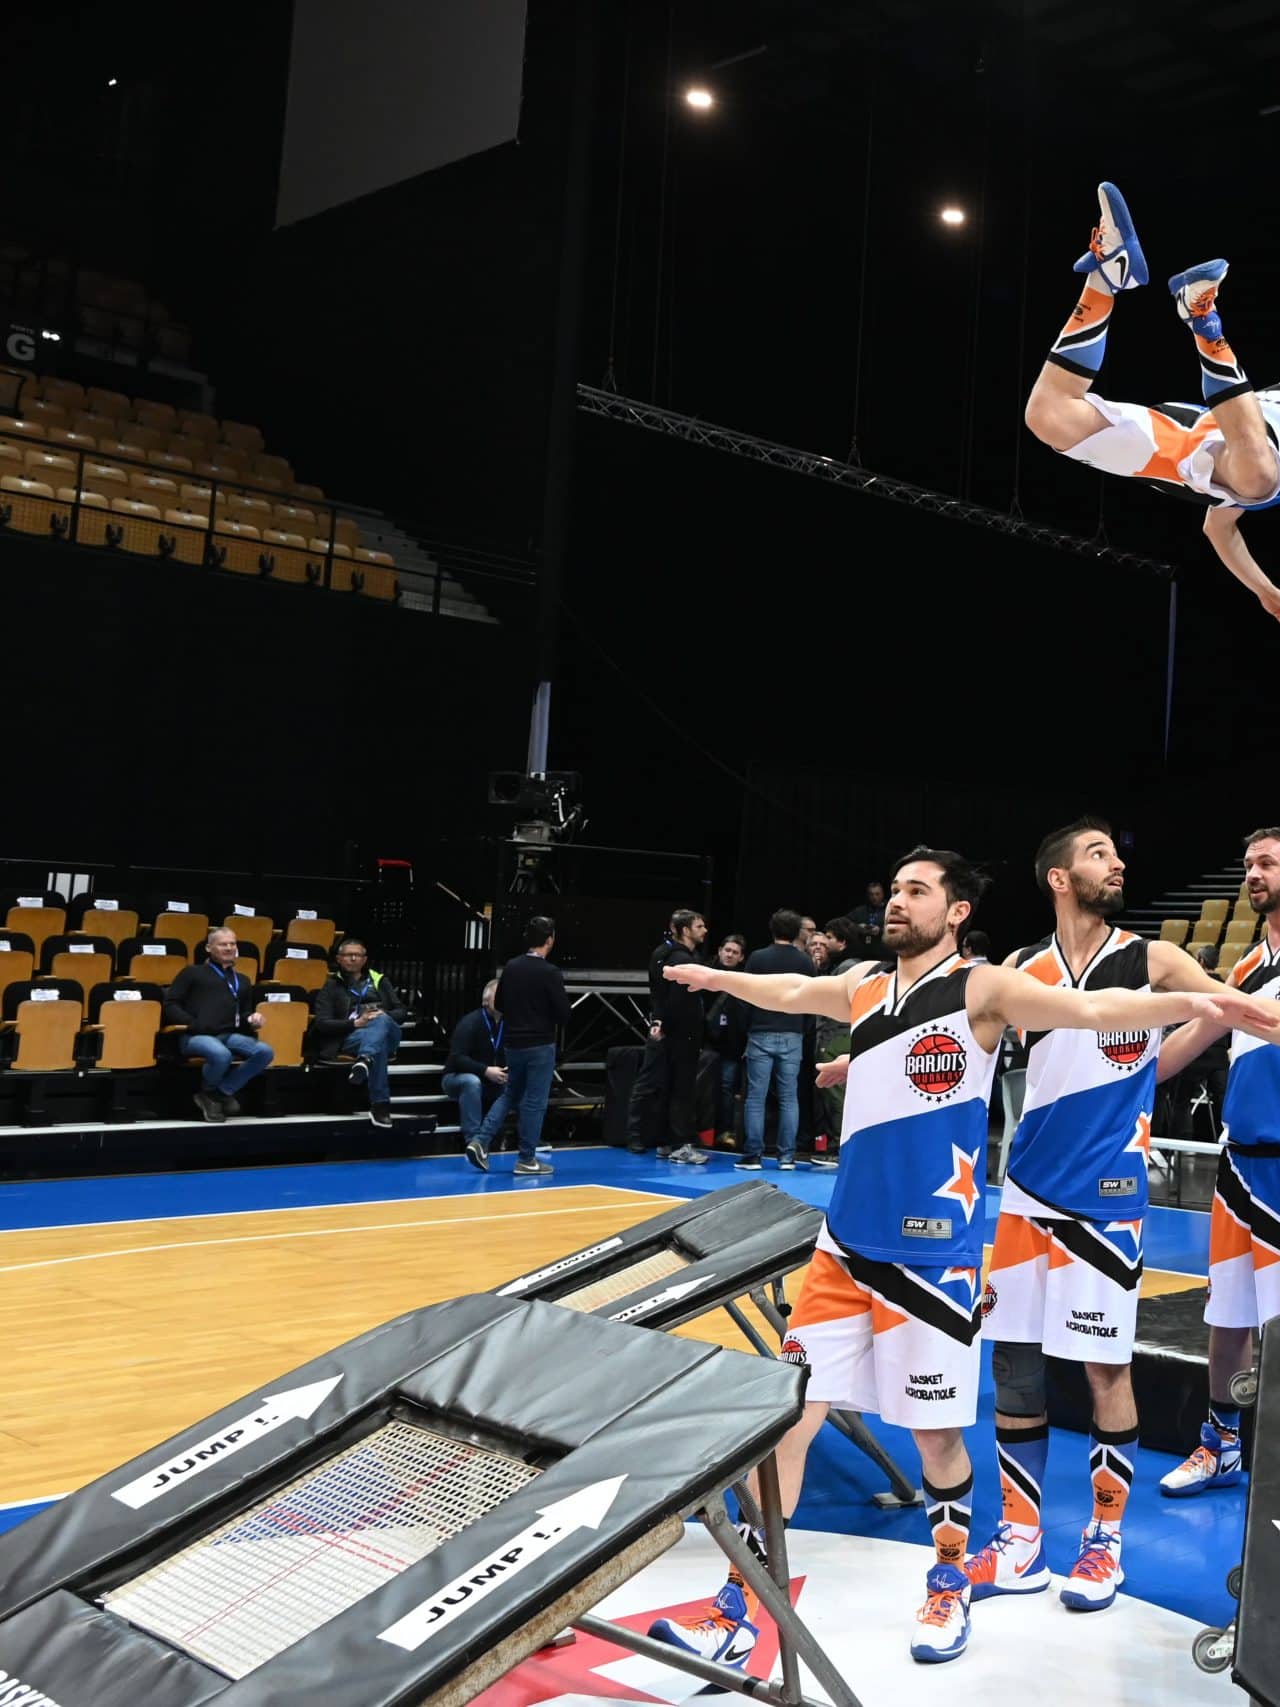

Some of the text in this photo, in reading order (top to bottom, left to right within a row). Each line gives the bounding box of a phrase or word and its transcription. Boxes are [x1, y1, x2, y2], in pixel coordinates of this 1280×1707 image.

[6, 332, 36, 361] G
[906, 1052, 966, 1075] BARJOTS
[1102, 1181, 1119, 1189] SW
[905, 1220, 943, 1230] SW S
[1071, 1310, 1105, 1323] BASKET
[1065, 1320, 1119, 1339] ACROBATIQUE
[908, 1373, 944, 1385] BASKET
[152, 1429, 245, 1488] JUMP
[425, 1546, 524, 1624] JUMP
